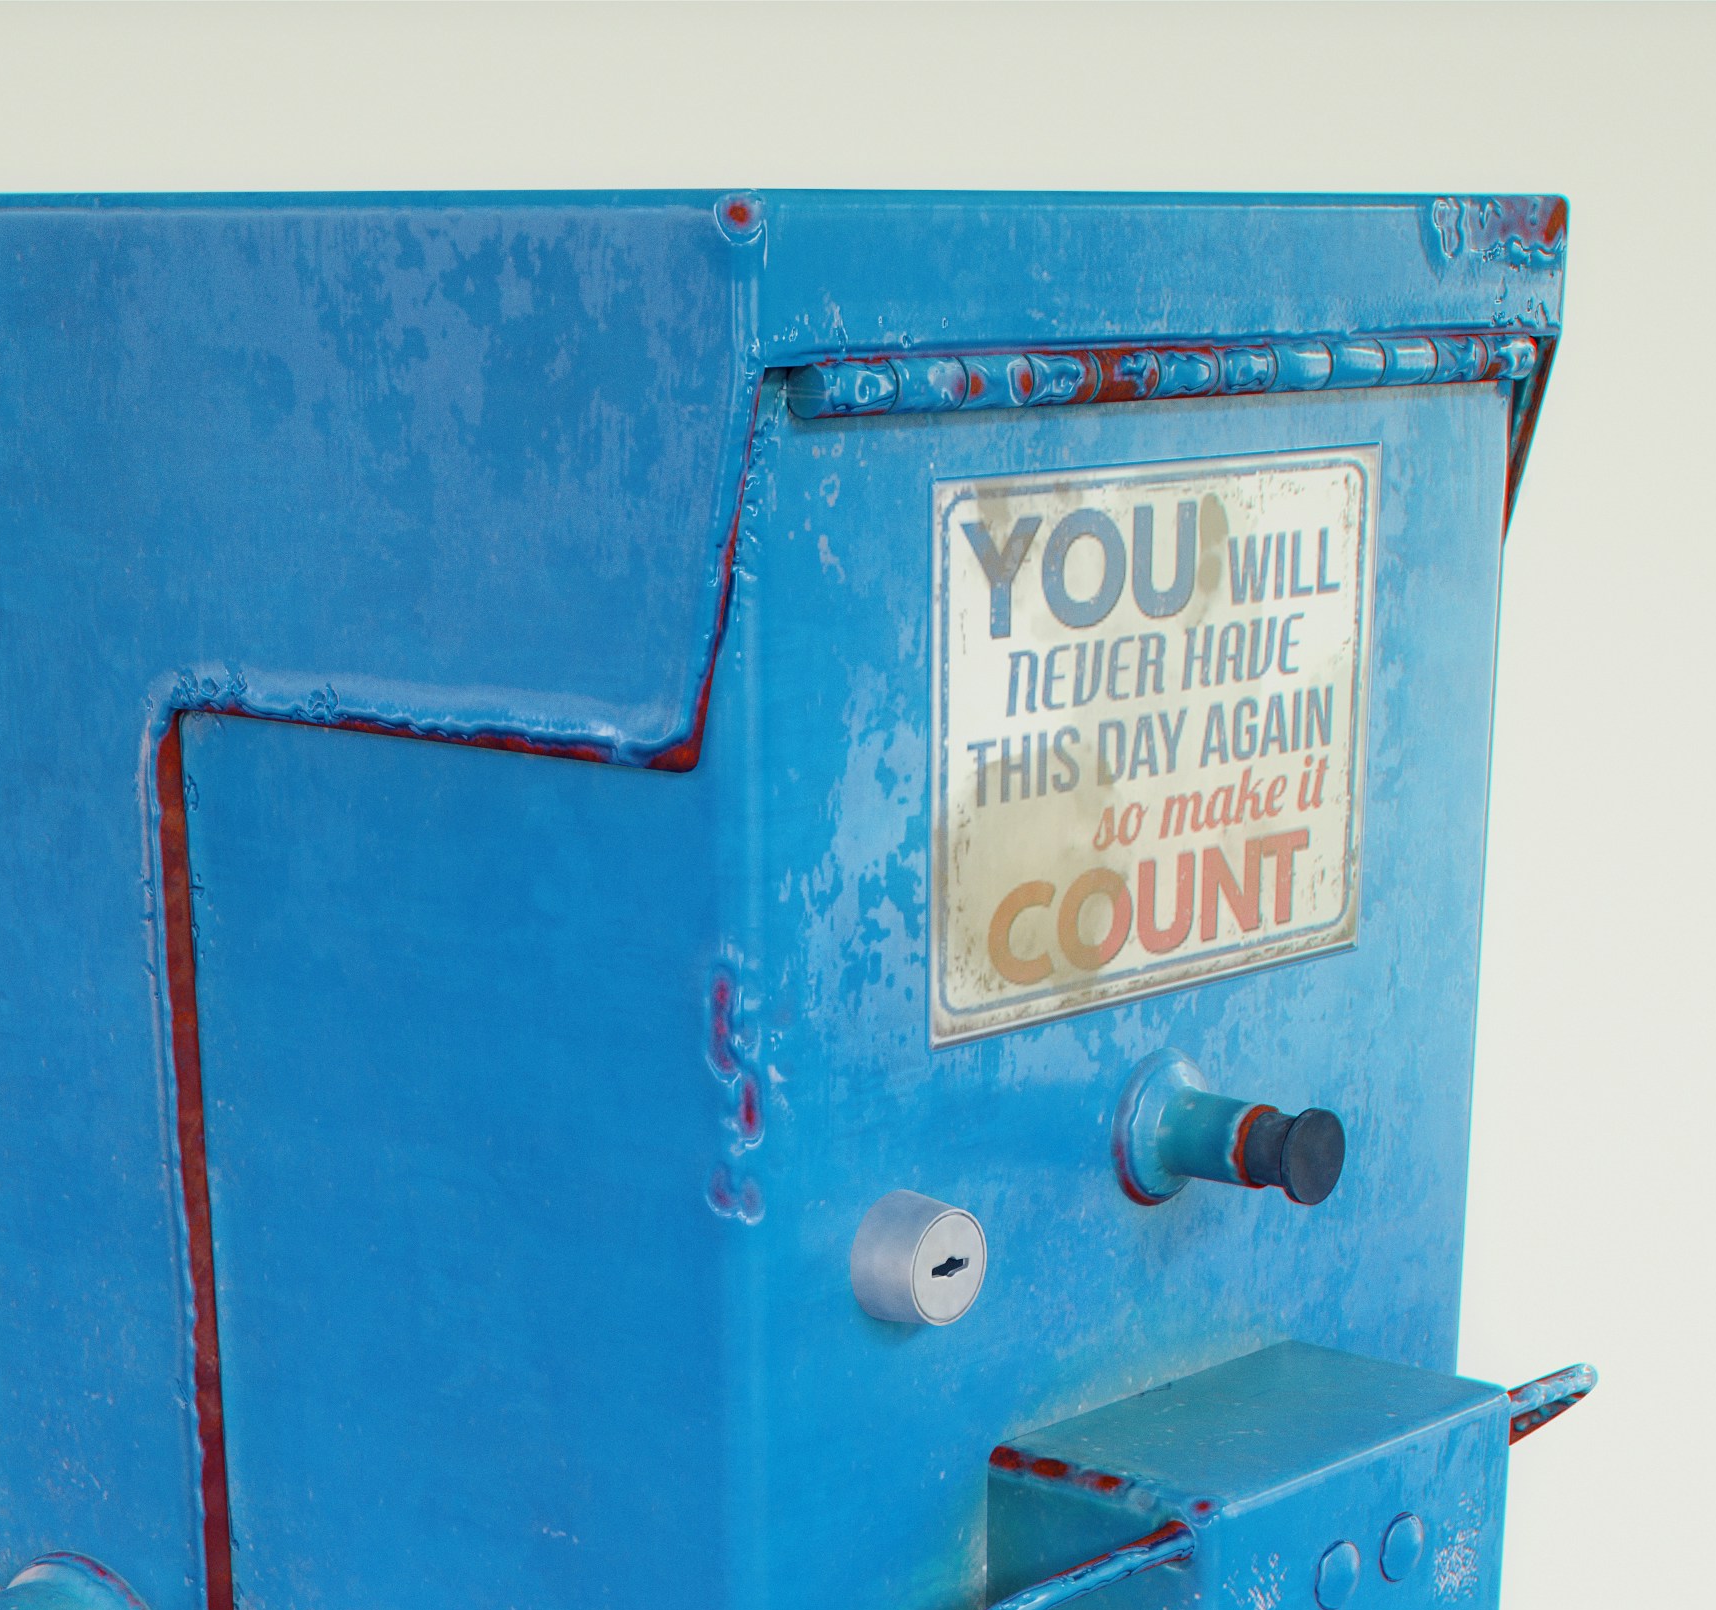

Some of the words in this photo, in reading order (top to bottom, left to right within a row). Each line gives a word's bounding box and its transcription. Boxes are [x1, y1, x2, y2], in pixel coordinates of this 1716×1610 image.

[959, 499, 1198, 640] YOU
[1227, 527, 1340, 605] WILL
[1006, 632, 1166, 717] NEVER
[1182, 612, 1305, 690] HAVE
[967, 729, 1081, 808] THIS
[1096, 708, 1187, 787] DAY
[1199, 683, 1334, 768] AGAIN
[1092, 798, 1149, 852] so
[1160, 767, 1284, 840] make
[1298, 754, 1330, 810] it
[987, 829, 1309, 985] COUNT
